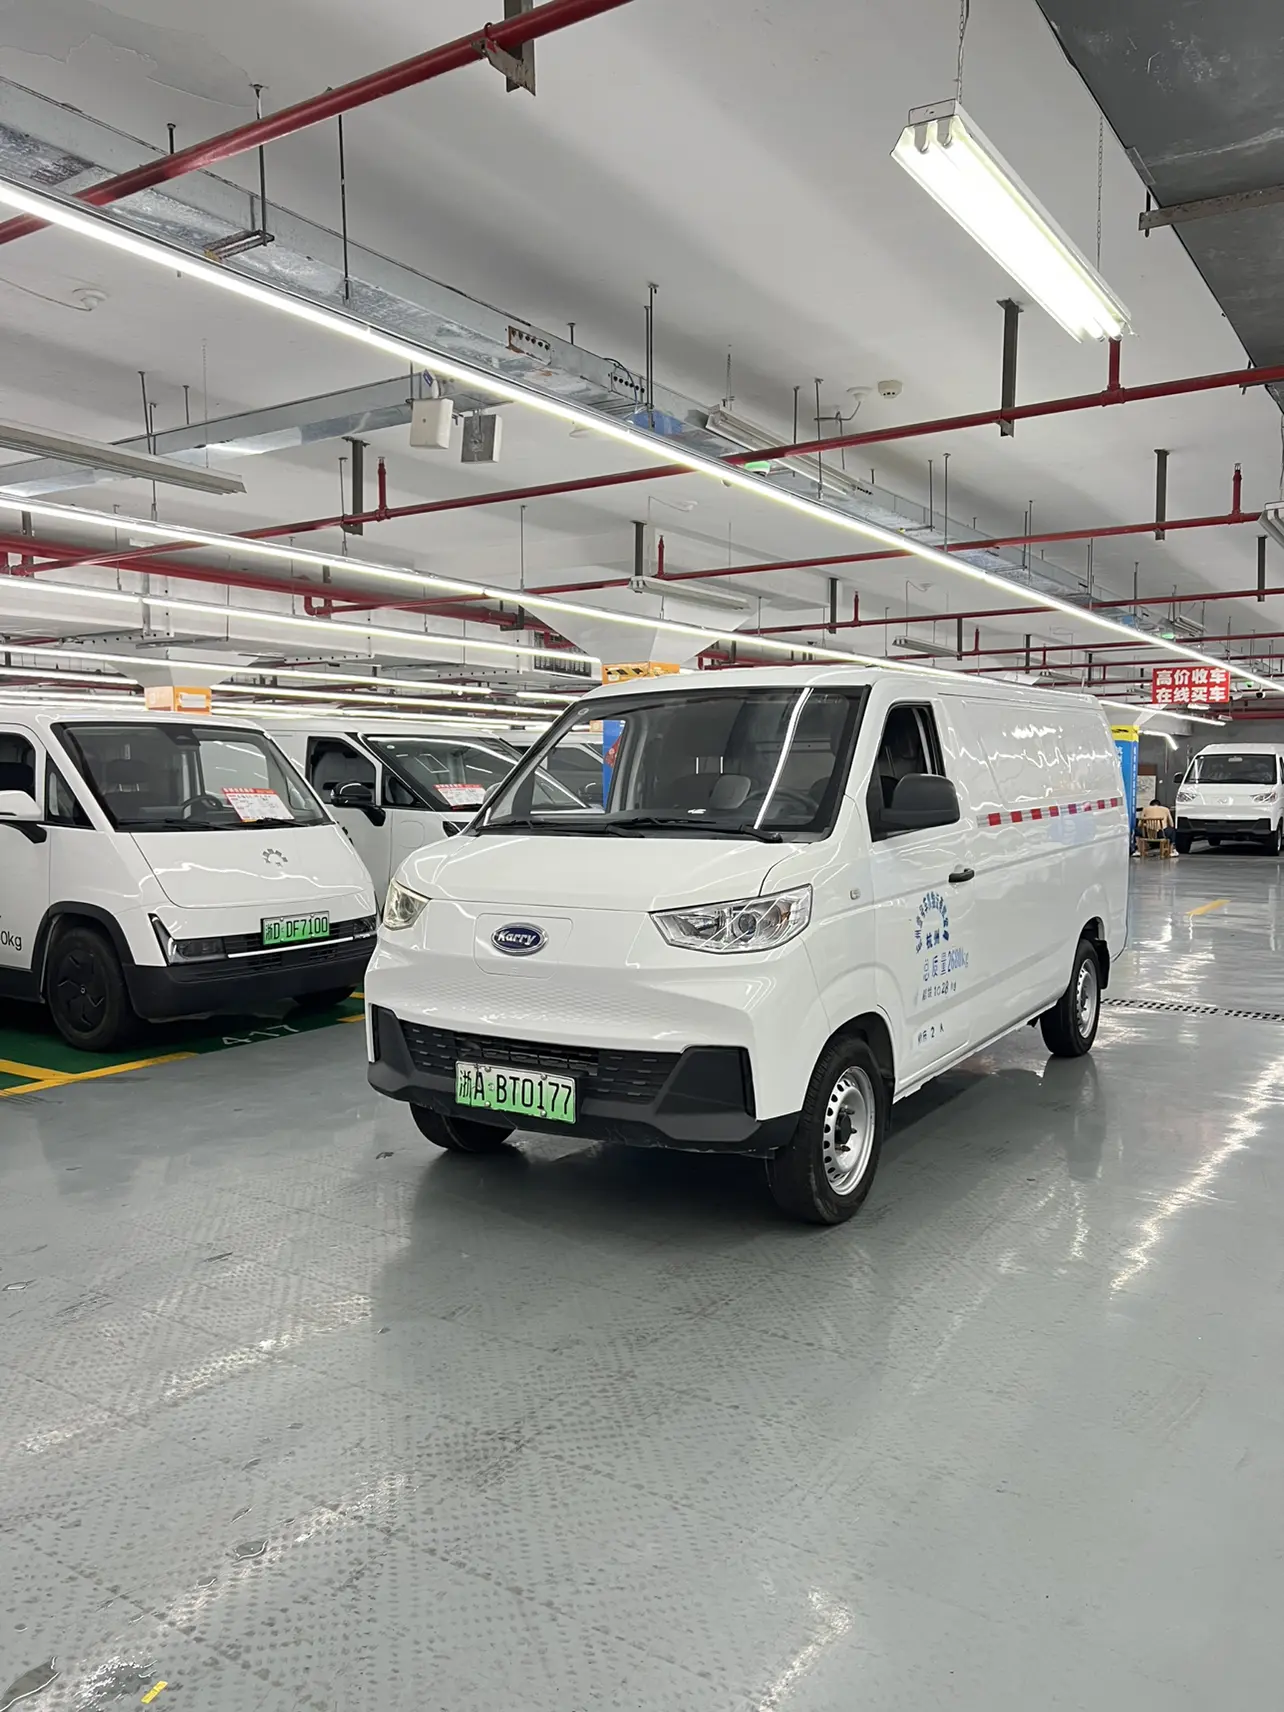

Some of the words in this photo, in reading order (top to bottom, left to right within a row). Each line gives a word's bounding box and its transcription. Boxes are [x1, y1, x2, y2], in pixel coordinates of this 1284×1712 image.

[1156, 668, 1227, 685] 高价收车
[1155, 686, 1226, 703] 在线买车
[286, 916, 328, 938] DF7100
[498, 930, 536, 946] Karry
[496, 1074, 572, 1115] BT0177
